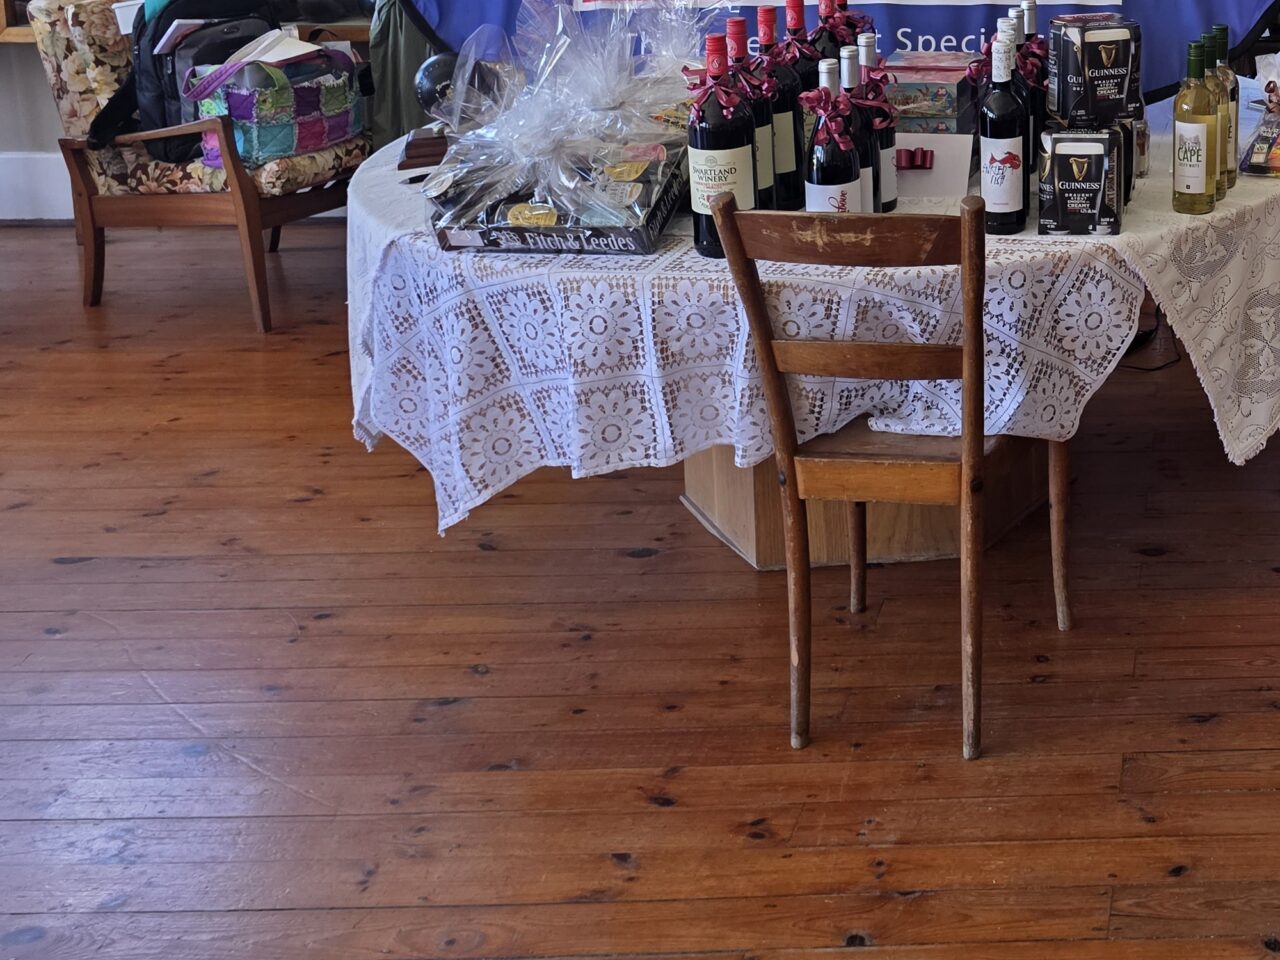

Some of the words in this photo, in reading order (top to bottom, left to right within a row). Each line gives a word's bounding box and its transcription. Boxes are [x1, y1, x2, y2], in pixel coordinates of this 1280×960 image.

[1089, 68, 1128, 77] GUINNESS
[1178, 146, 1202, 162] CAPE
[693, 166, 737, 176] SWARTLAND
[698, 174, 729, 182] WINERY
[1058, 181, 1101, 190] GUINNESS
[524, 232, 565, 250] Fitch
[565, 233, 581, 250] &
[579, 232, 636, 251] Leedes
